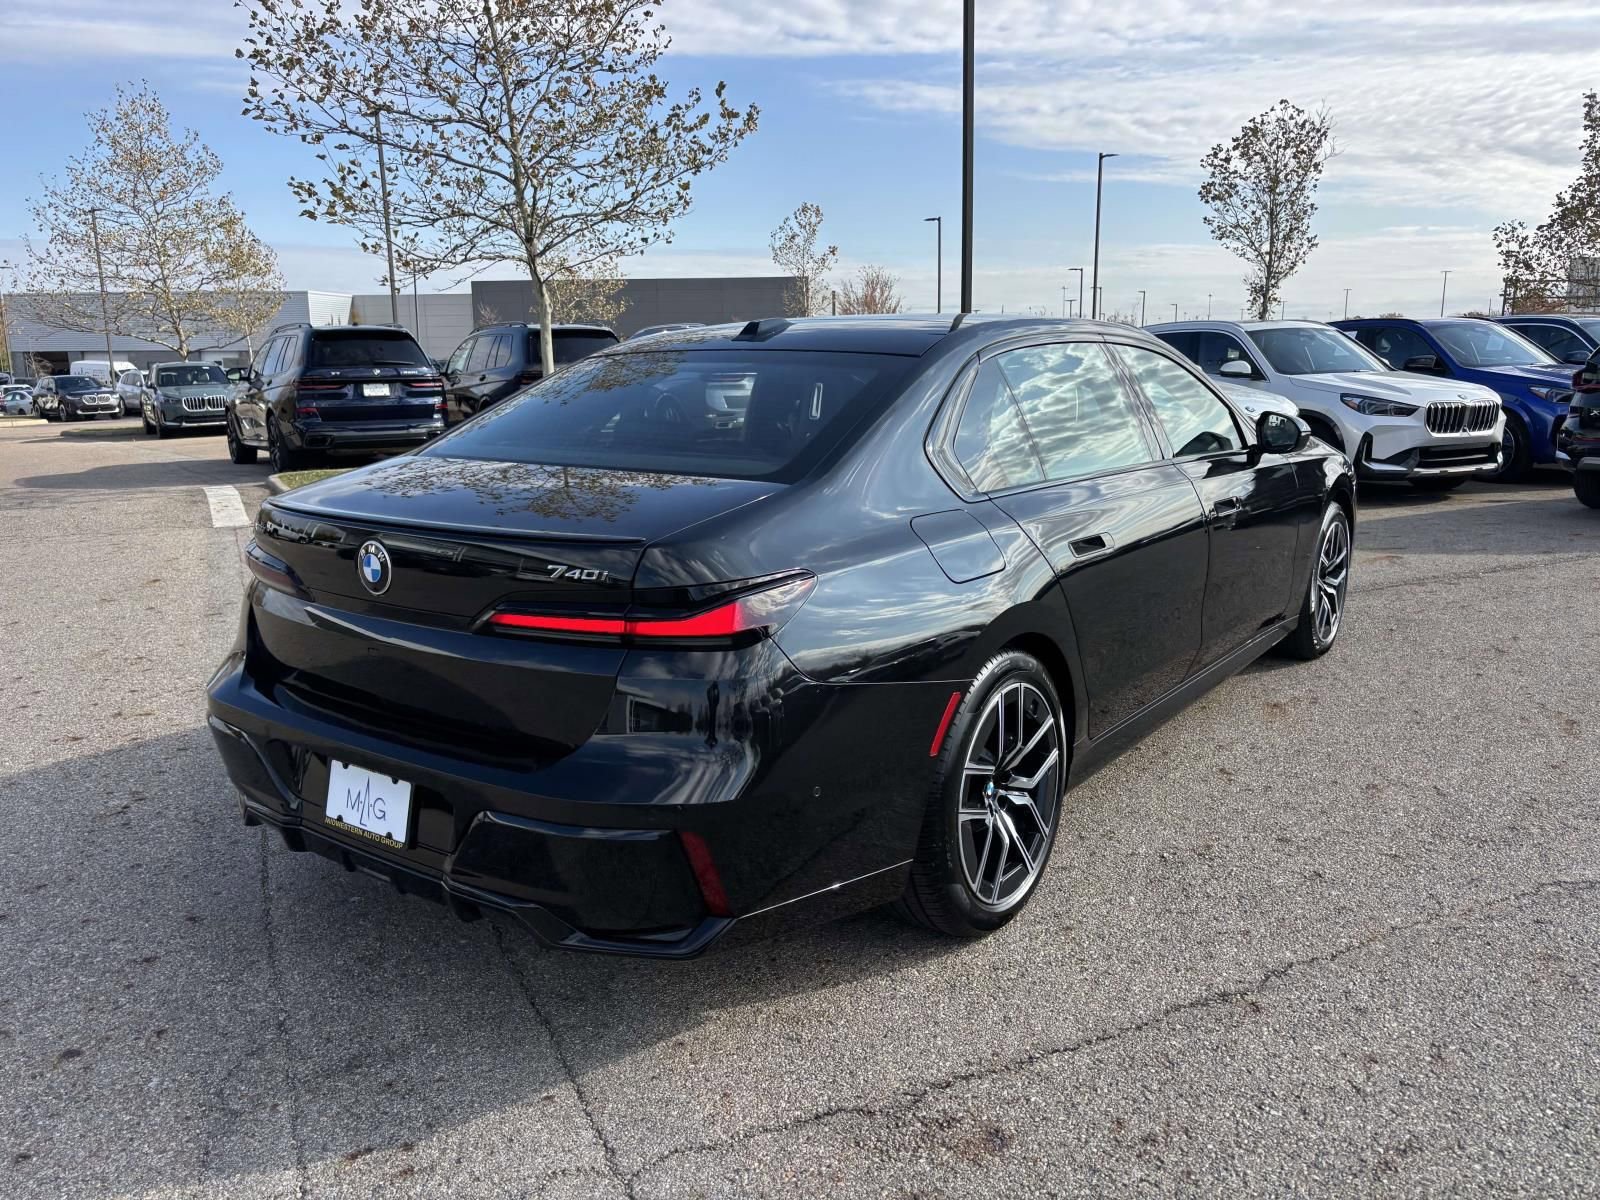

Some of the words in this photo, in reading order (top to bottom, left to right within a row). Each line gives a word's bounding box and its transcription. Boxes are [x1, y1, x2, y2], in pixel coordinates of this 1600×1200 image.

[360, 544, 386, 562] BMW
[547, 565, 609, 581] 740i
[363, 831, 380, 842] AUTO
[380, 836, 403, 849] GROUP
